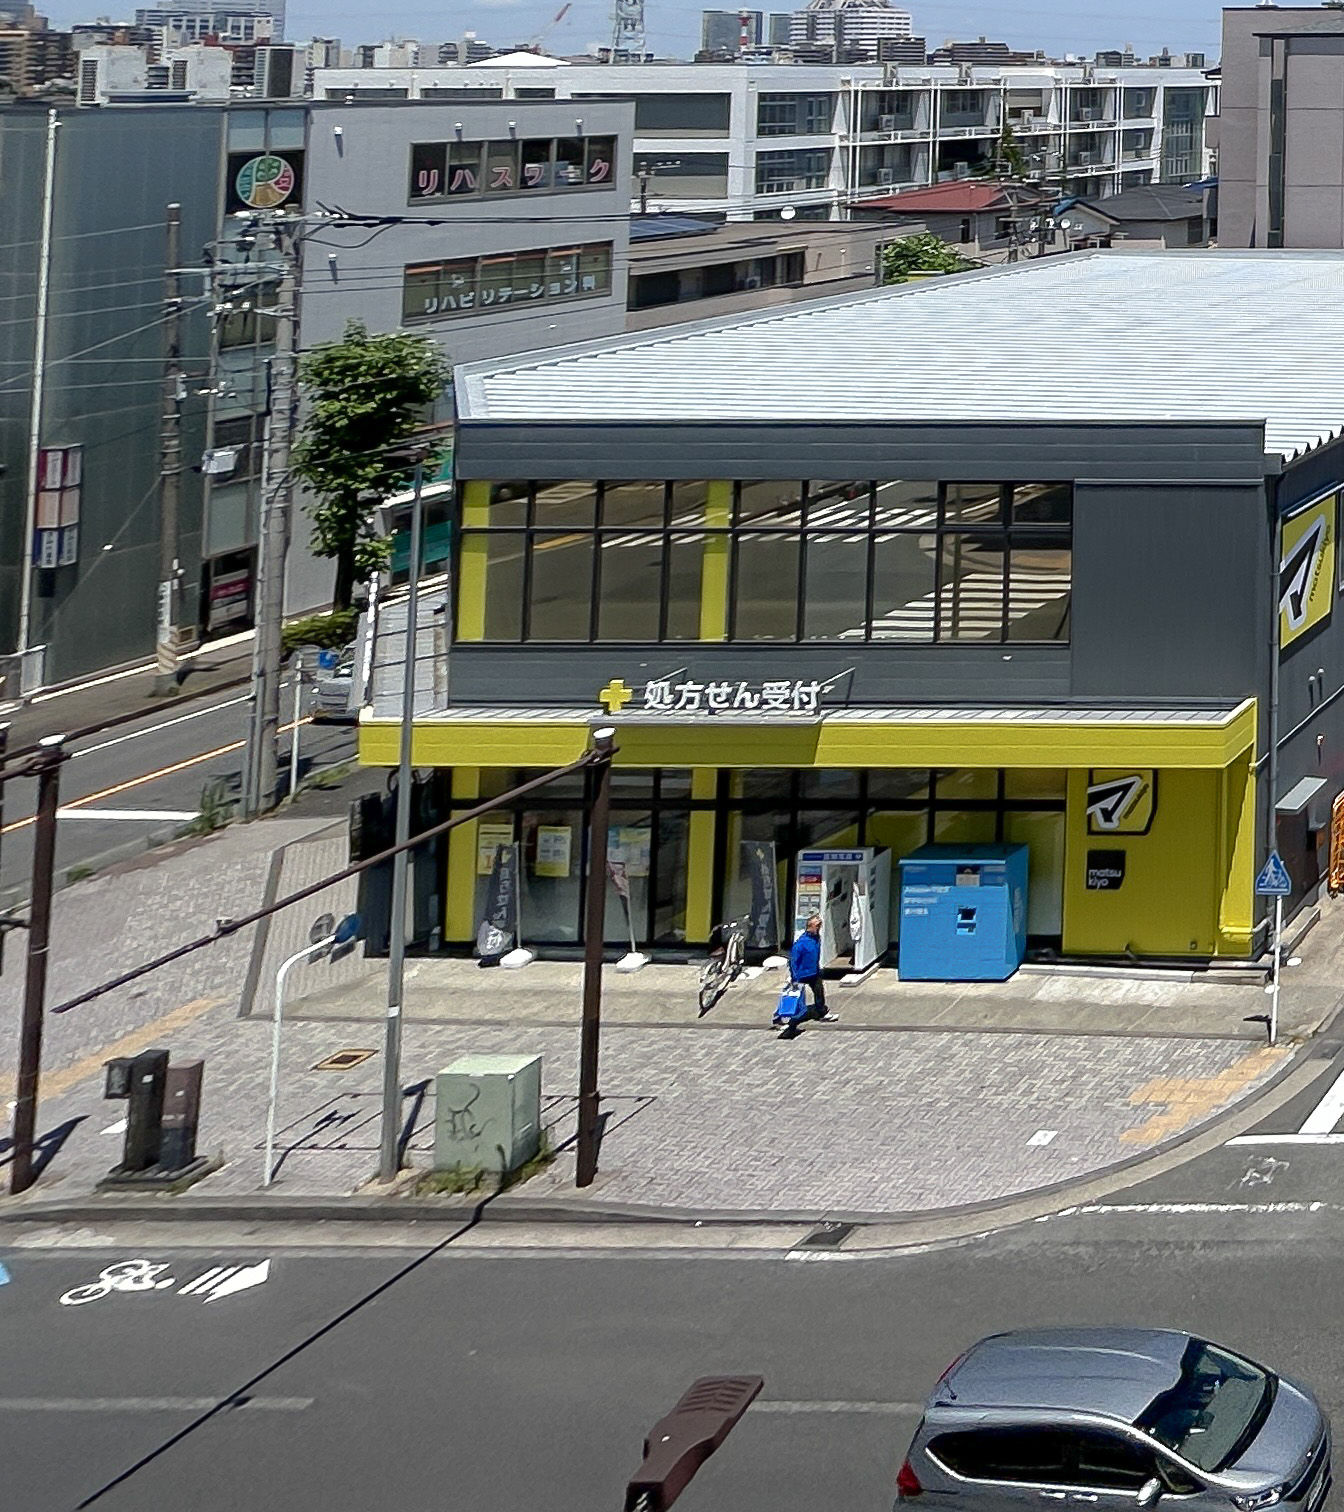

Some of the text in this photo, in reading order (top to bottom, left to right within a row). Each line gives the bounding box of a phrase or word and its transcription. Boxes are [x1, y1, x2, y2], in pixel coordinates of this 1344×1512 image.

[418, 159, 609, 195] リハスワーク
[643, 679, 821, 710] 処方せん受付
[1088, 868, 1122, 878] matsu
[1088, 877, 1109, 890] kiyo
